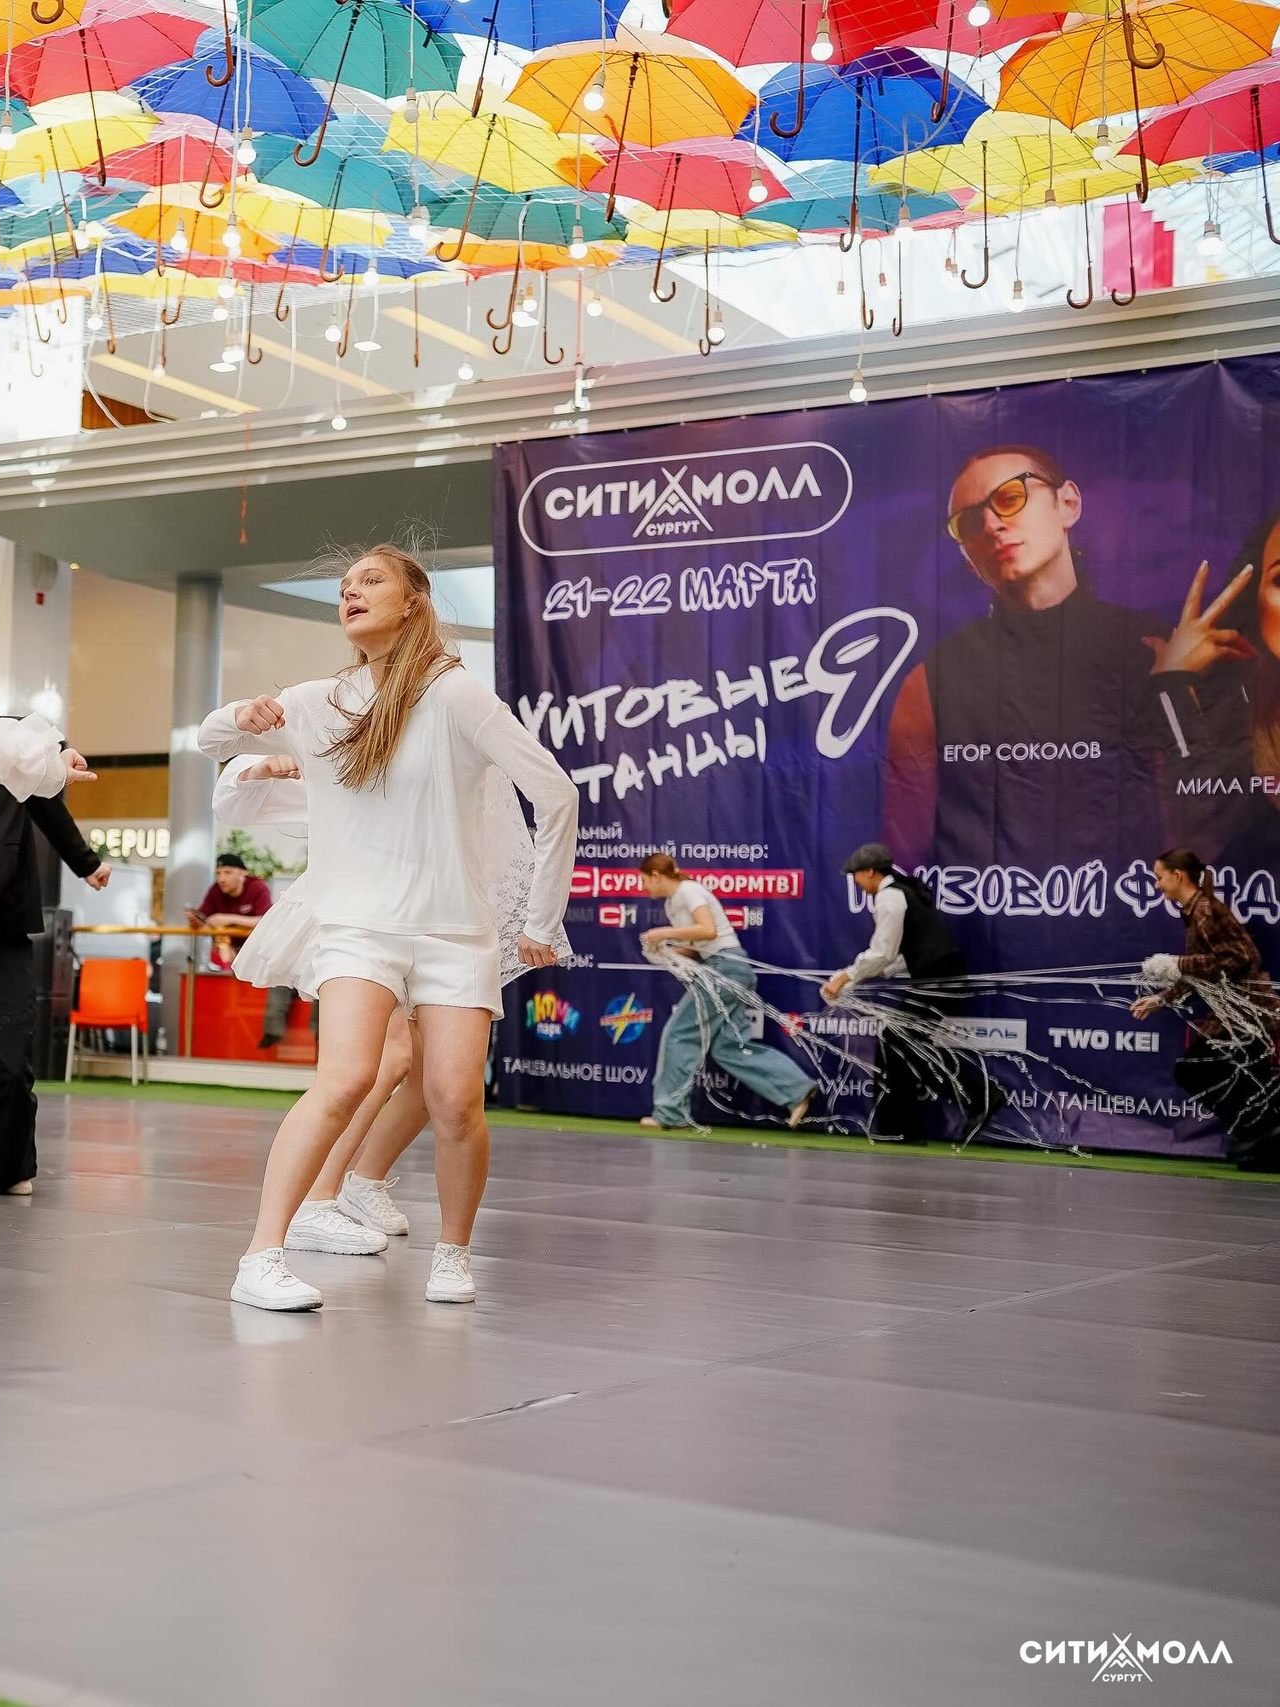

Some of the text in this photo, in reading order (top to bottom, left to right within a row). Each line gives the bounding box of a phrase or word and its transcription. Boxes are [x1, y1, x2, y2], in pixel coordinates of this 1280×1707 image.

[645, 519, 701, 537] СУРГУТ
[542, 557, 817, 621] 21-22 МАРТА
[570, 716, 767, 805] ТАНЦЫ
[943, 741, 1102, 762] ЕГОР СОКОЛОВ
[1175, 775, 1280, 796] МИЛА РЕ
[681, 843, 769, 863] партнер:
[1114, 859, 1280, 925] ФНД
[809, 1016, 888, 1037] YAMAGUC
[1048, 1027, 1161, 1053] TWO KEI
[605, 1065, 650, 1084] ШОУ
